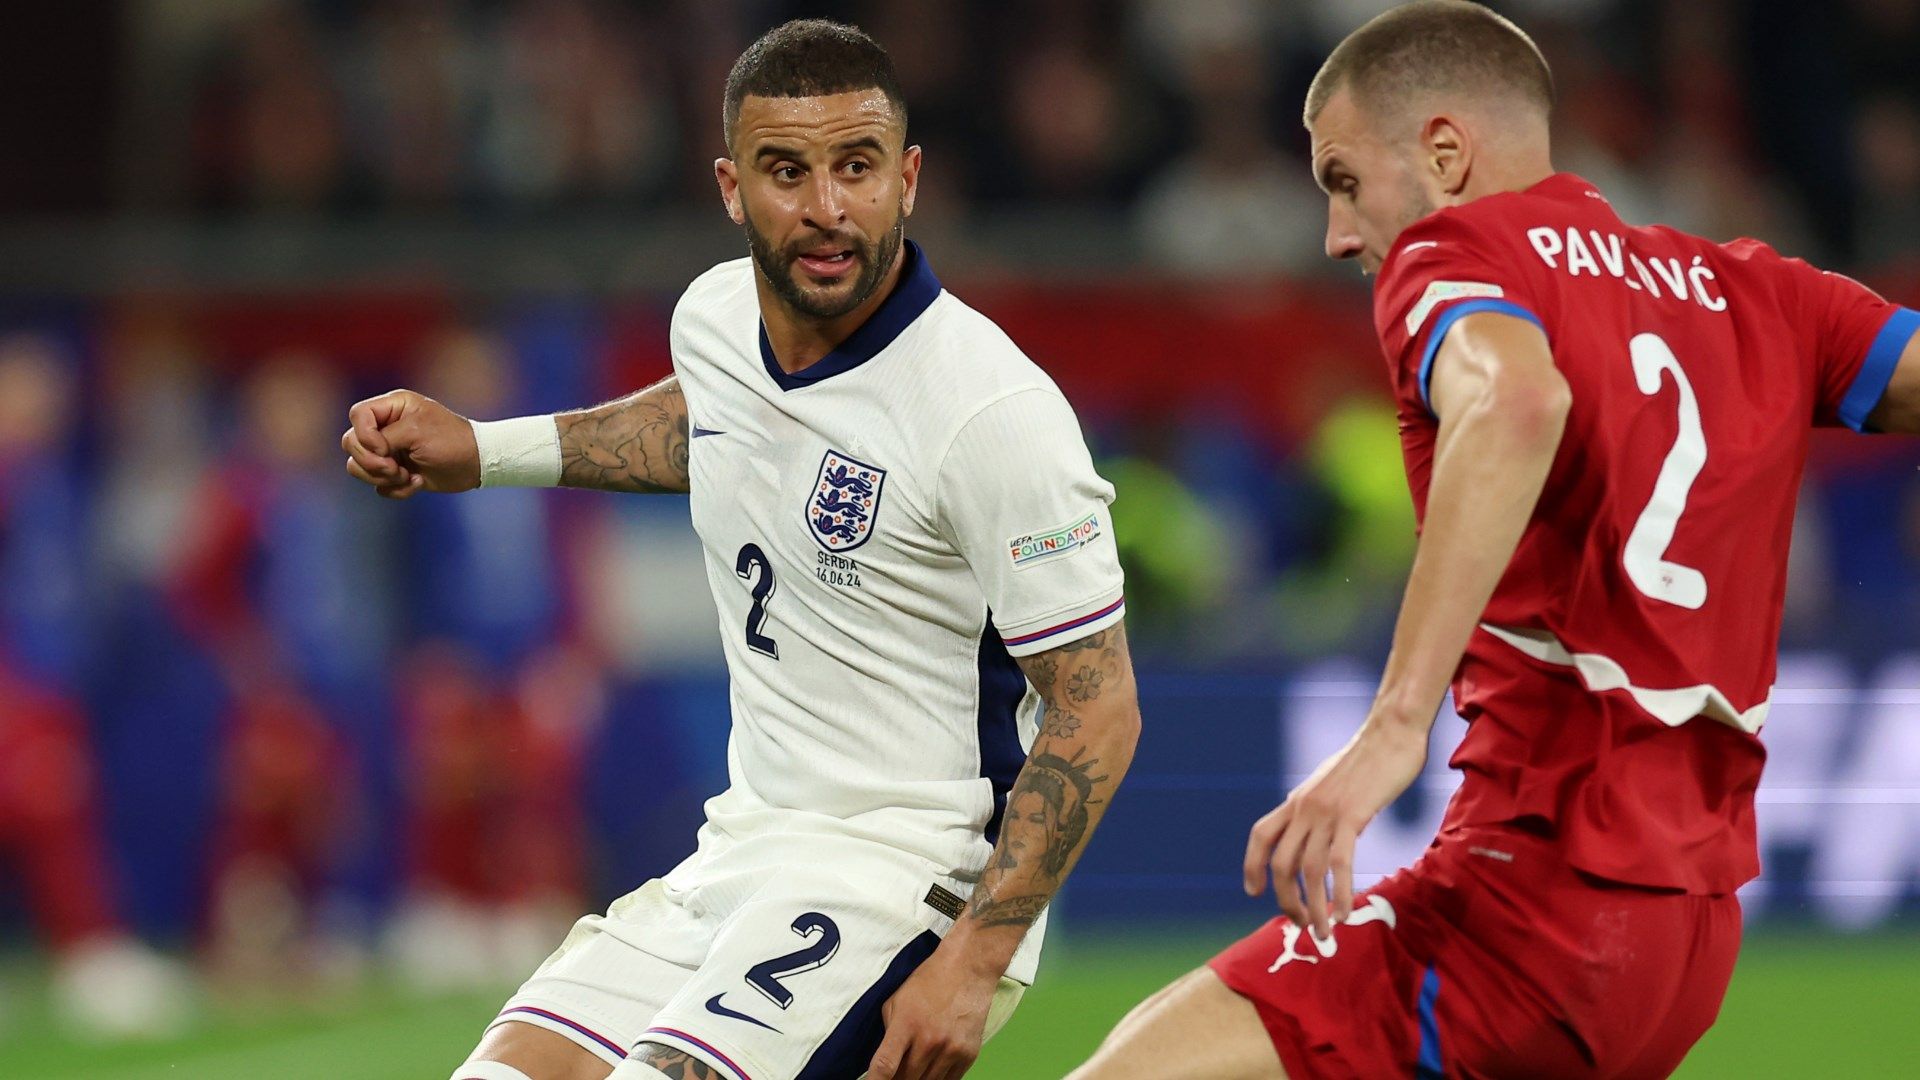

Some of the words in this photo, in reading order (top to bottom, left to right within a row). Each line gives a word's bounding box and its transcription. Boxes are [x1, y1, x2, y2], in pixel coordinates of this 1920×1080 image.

[1527, 226, 1727, 312] PAVOVĆ
[1623, 332, 1708, 610] 2
[817, 550, 858, 571] SERBIA
[1010, 535, 1032, 548] UEFA
[1011, 516, 1099, 560] FOUNDATION
[736, 542, 779, 661] 2
[816, 567, 861, 587] 16.06.24
[745, 911, 841, 1010] 2
